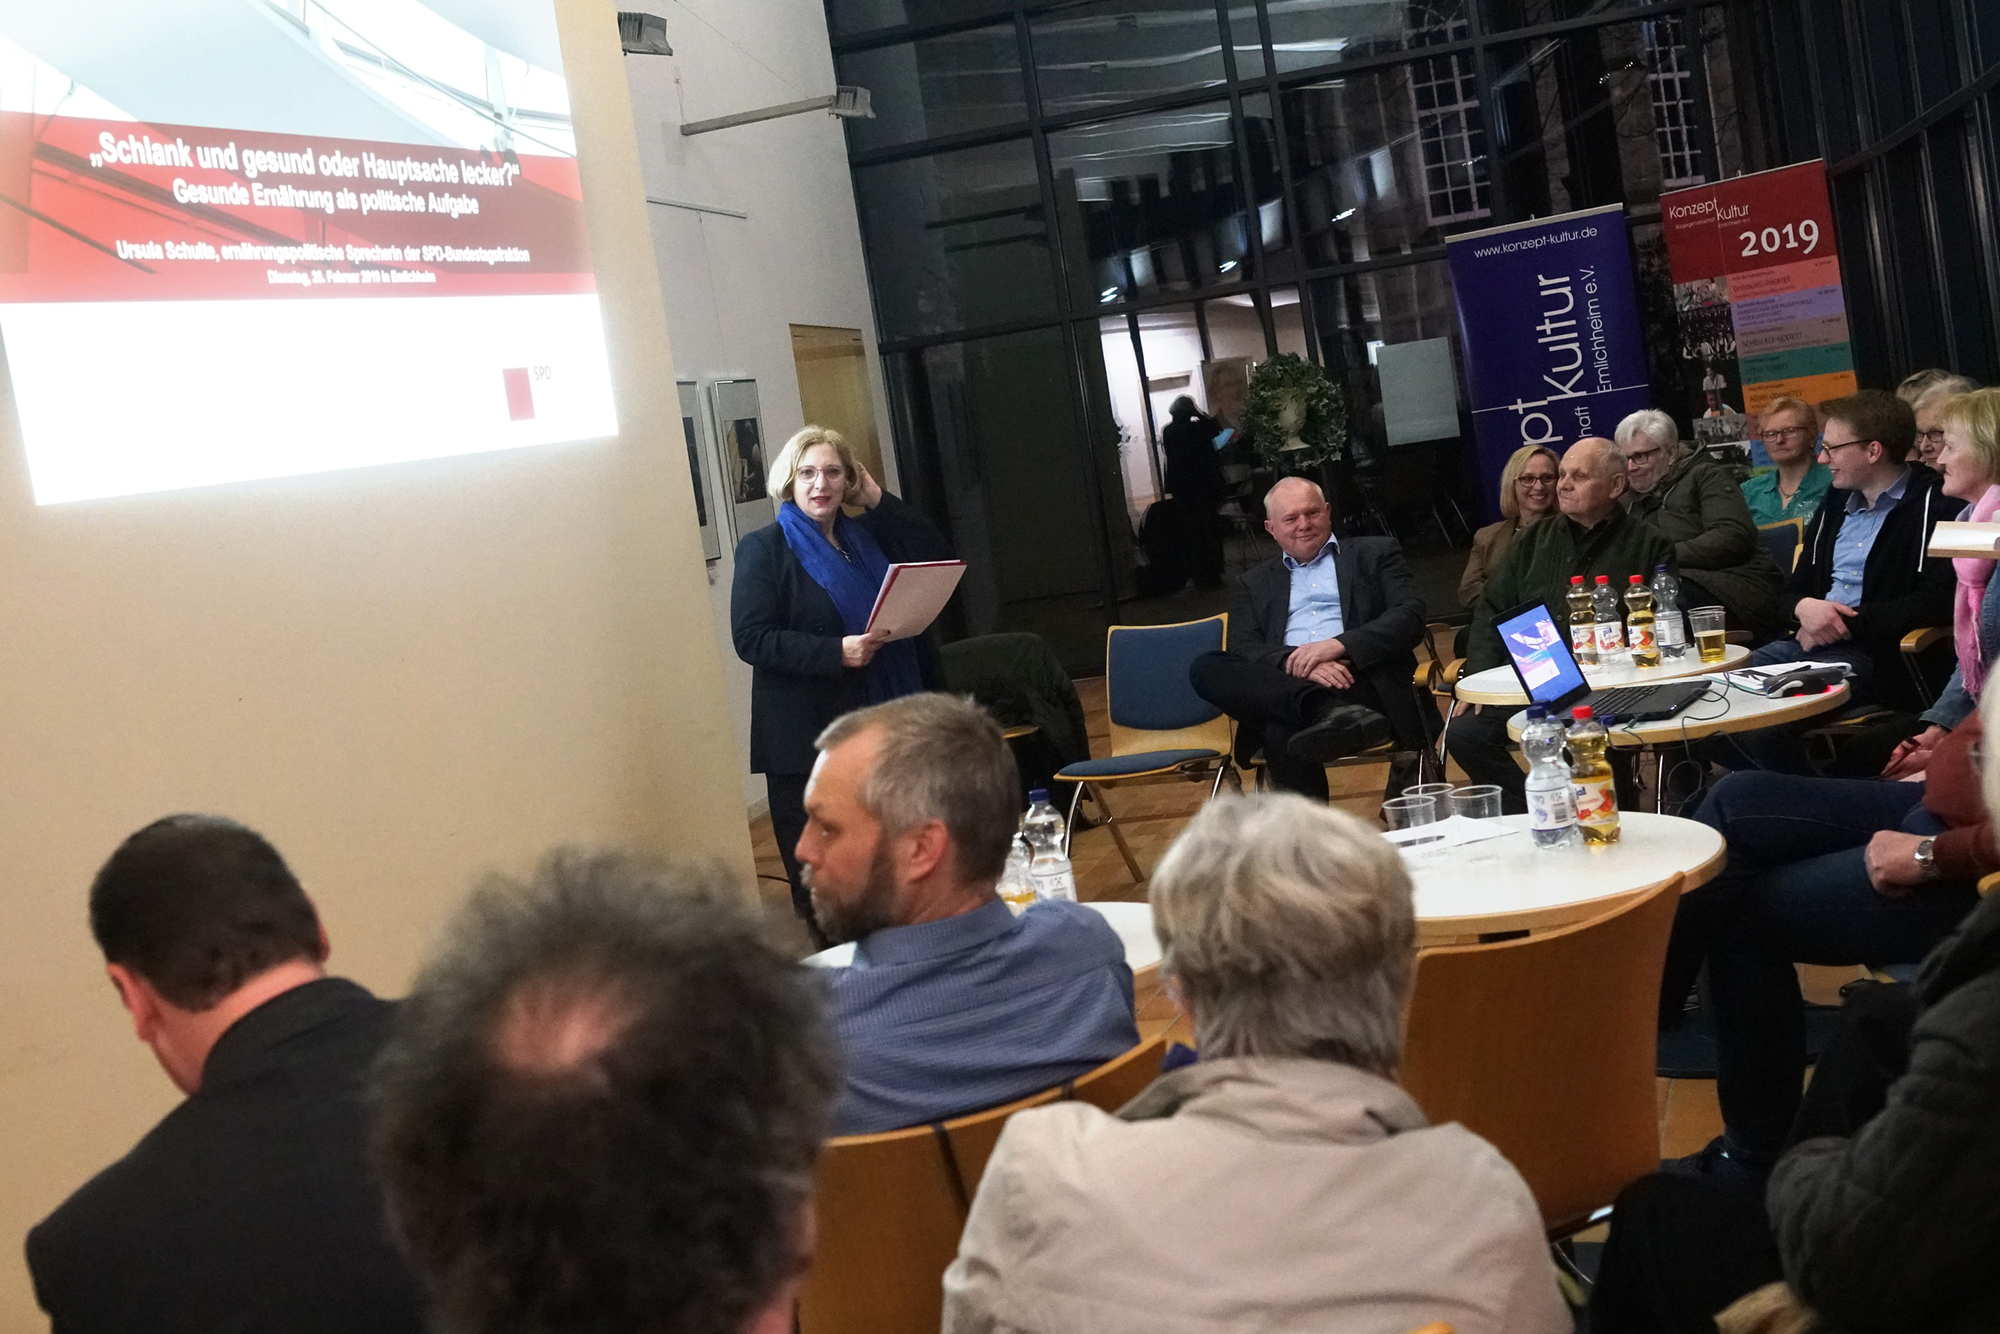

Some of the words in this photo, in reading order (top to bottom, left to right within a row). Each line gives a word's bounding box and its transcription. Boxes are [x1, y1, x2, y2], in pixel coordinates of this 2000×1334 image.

[196, 142, 239, 170] und
[242, 147, 315, 179] gesund
[319, 150, 359, 177] oder
[362, 152, 459, 186] Hauptsache
[173, 178, 250, 204] Gesunde
[251, 182, 334, 214] Ernährung
[336, 188, 358, 210] als
[360, 189, 426, 215] politische
[428, 192, 479, 219] Aufgabe
[1669, 197, 1718, 220] Konzept
[1716, 204, 1750, 222] Kultur
[116, 240, 164, 260] Ursula
[165, 240, 221, 263] Schulte,
[221, 242, 345, 265] ernährungspolitische
[345, 244, 403, 265] Sprecherin
[404, 245, 421, 262] der
[1474, 226, 1598, 259] www.konzept-kultur.de
[1739, 219, 1820, 257] 2019
[1536, 274, 1588, 401] Kultur
[1587, 298, 1613, 395] Emlichheim
[533, 365, 552, 381] SPD
